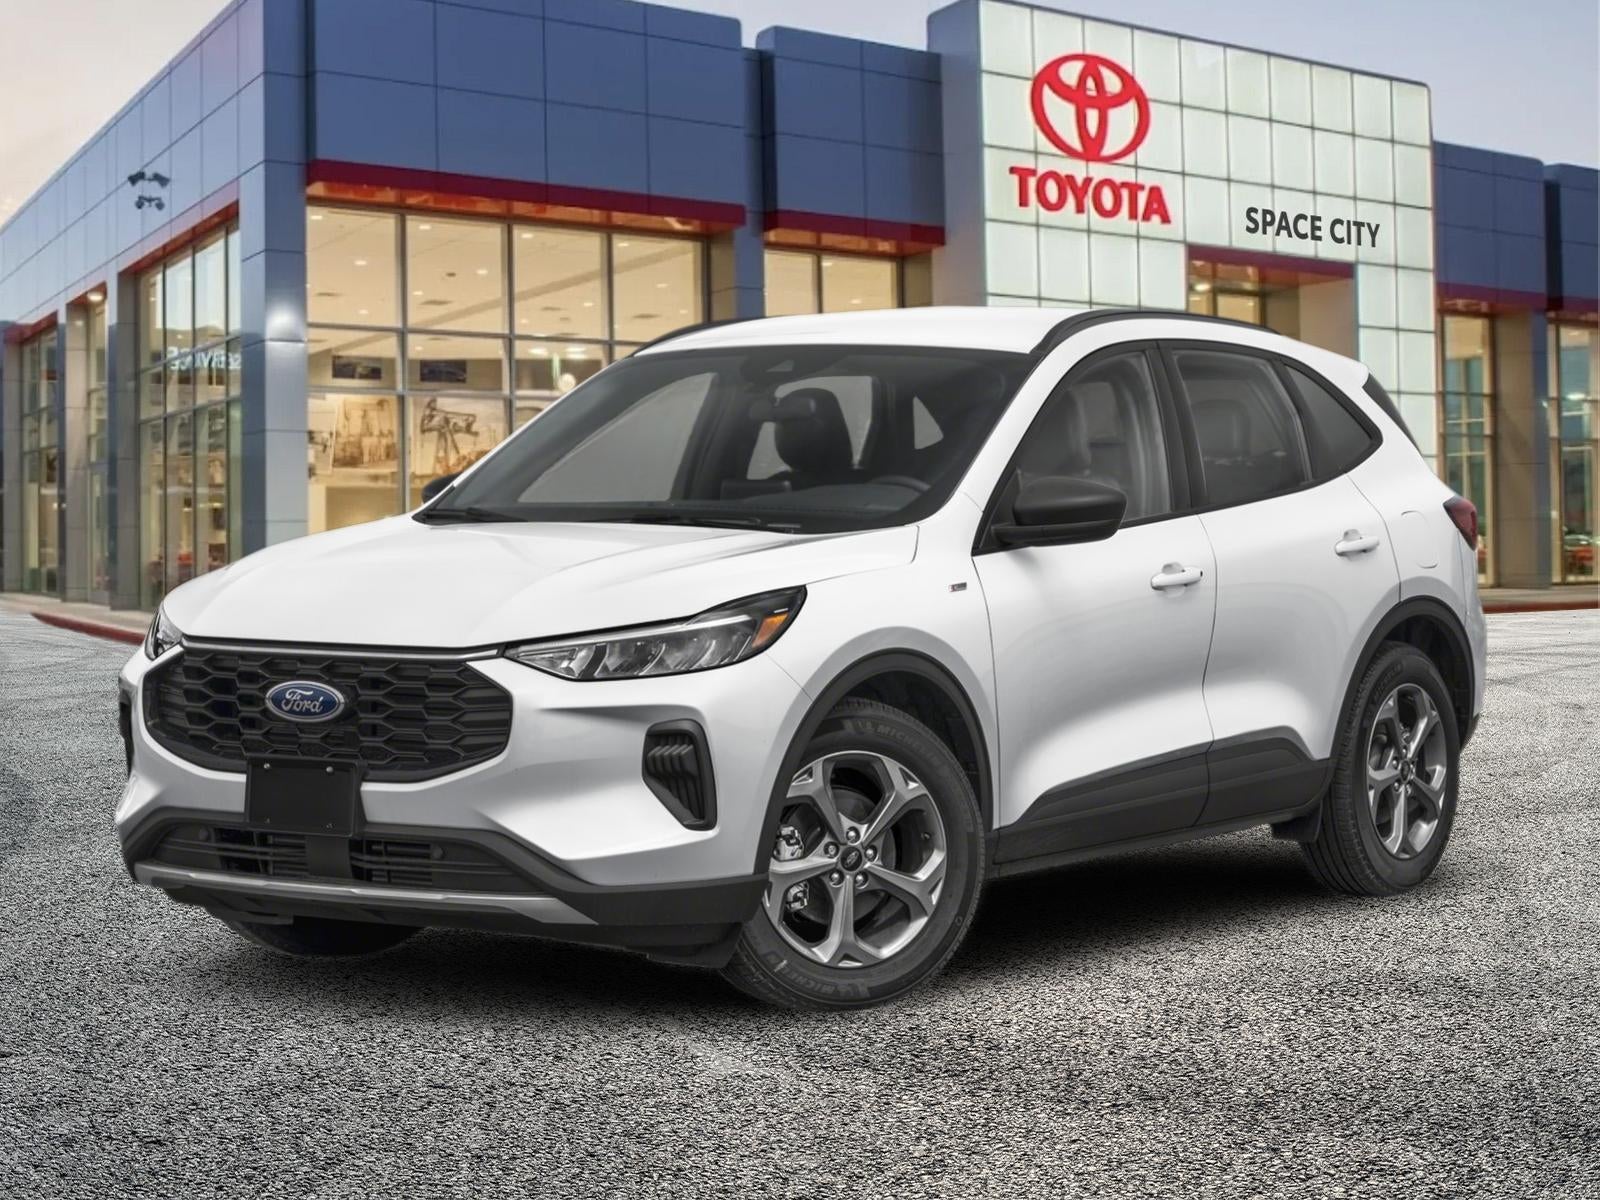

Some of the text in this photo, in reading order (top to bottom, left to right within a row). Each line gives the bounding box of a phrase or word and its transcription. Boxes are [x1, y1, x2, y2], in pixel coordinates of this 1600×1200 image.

[1009, 166, 1171, 224] TOYOTA
[1245, 207, 1380, 248] SPACE CITY
[281, 688, 323, 712] Ford
